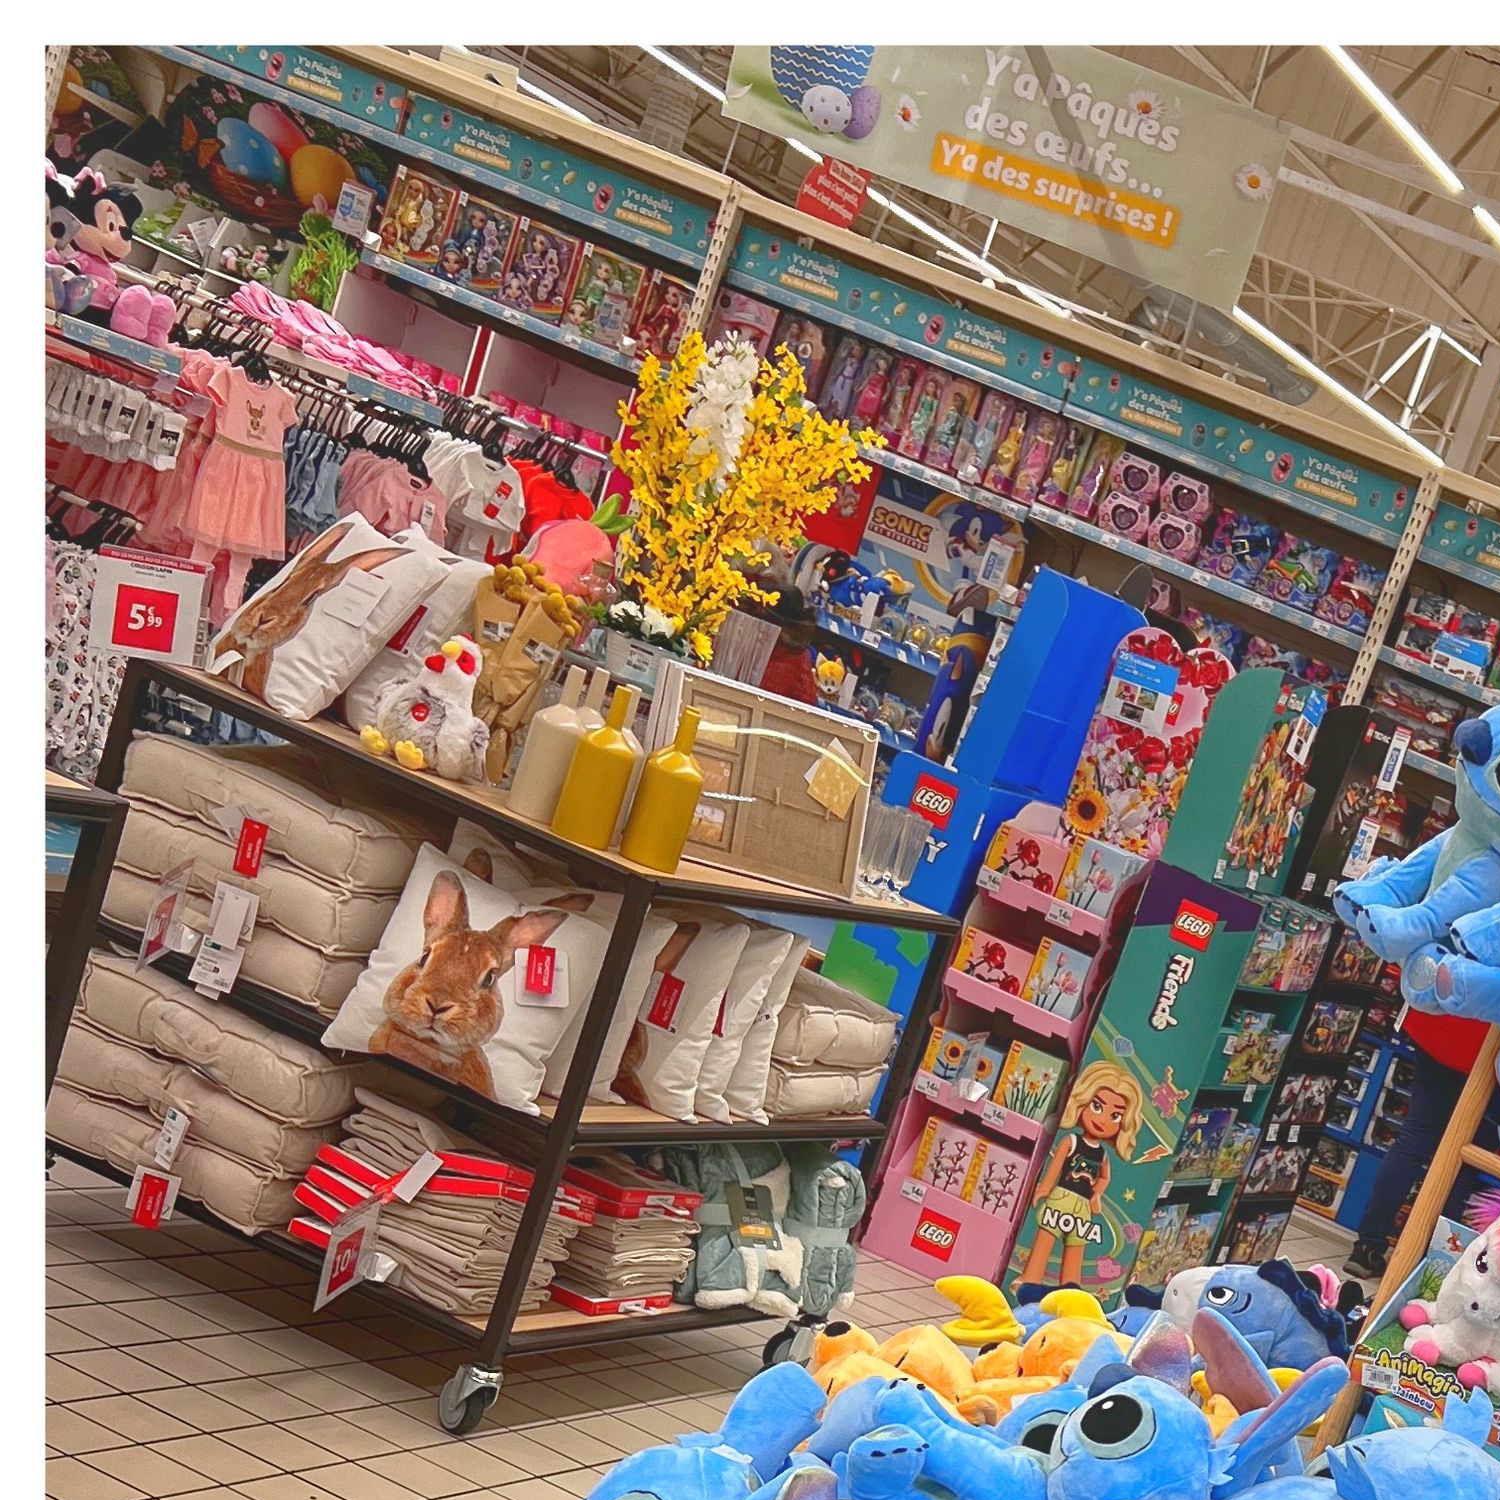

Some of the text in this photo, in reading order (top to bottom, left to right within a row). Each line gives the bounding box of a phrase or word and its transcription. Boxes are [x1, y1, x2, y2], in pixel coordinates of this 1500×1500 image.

[985, 48, 1180, 152] Y'a Pâques
[965, 97, 1029, 146] des
[941, 140, 978, 172] Y'a
[983, 156, 1030, 190] des
[1034, 178, 1156, 231] surprises
[873, 506, 934, 543] SONIC
[915, 788, 952, 814] LEGO
[1177, 913, 1212, 937] LEGO
[1152, 954, 1194, 1030] Friends
[918, 1222, 954, 1247] LEGO
[1043, 1208, 1102, 1243] NOVA
